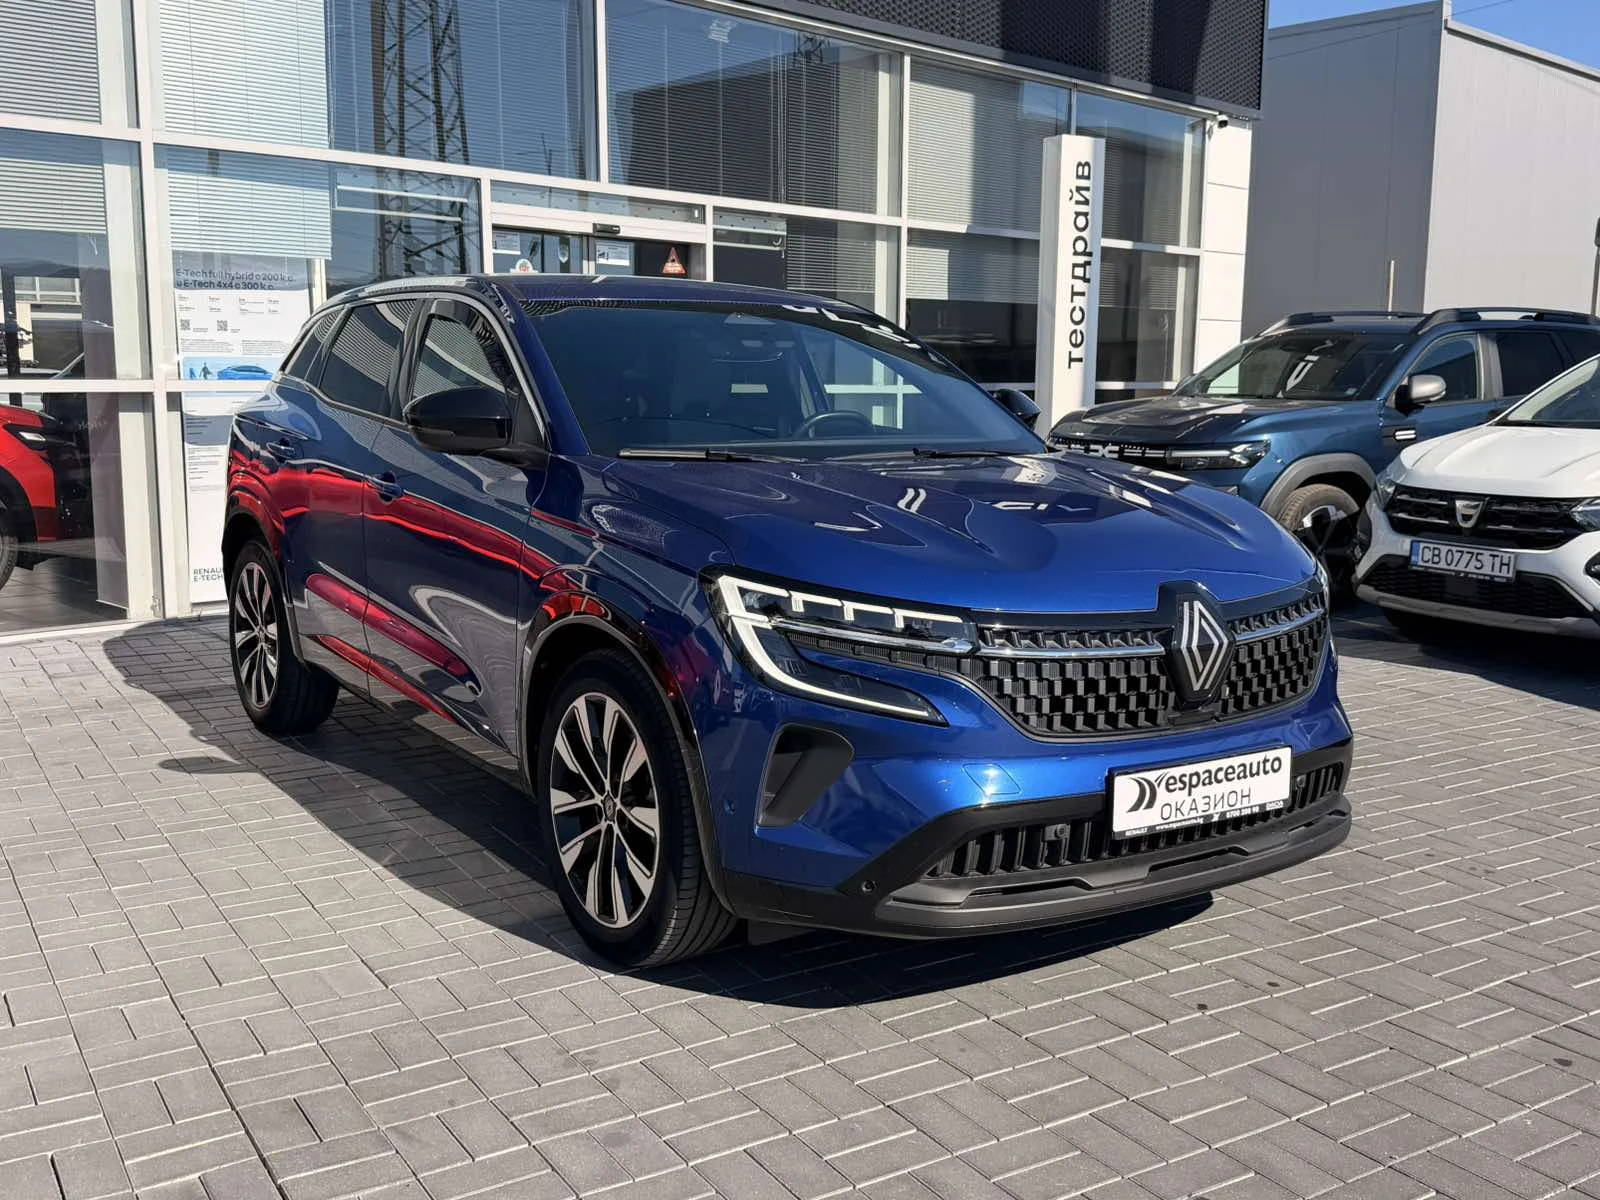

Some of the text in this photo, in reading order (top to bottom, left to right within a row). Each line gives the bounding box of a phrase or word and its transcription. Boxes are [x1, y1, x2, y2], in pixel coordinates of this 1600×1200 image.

[176, 269, 208, 278] E-Tech
[225, 271, 254, 281] hybrid
[1067, 160, 1094, 370] тестдрайв
[183, 280, 215, 289] E-Tech
[242, 282, 259, 290] 300
[1421, 546, 1512, 574] CB 0775 TH
[1164, 754, 1282, 797] espaceauto
[1160, 787, 1251, 821] ОКАЗИОН
